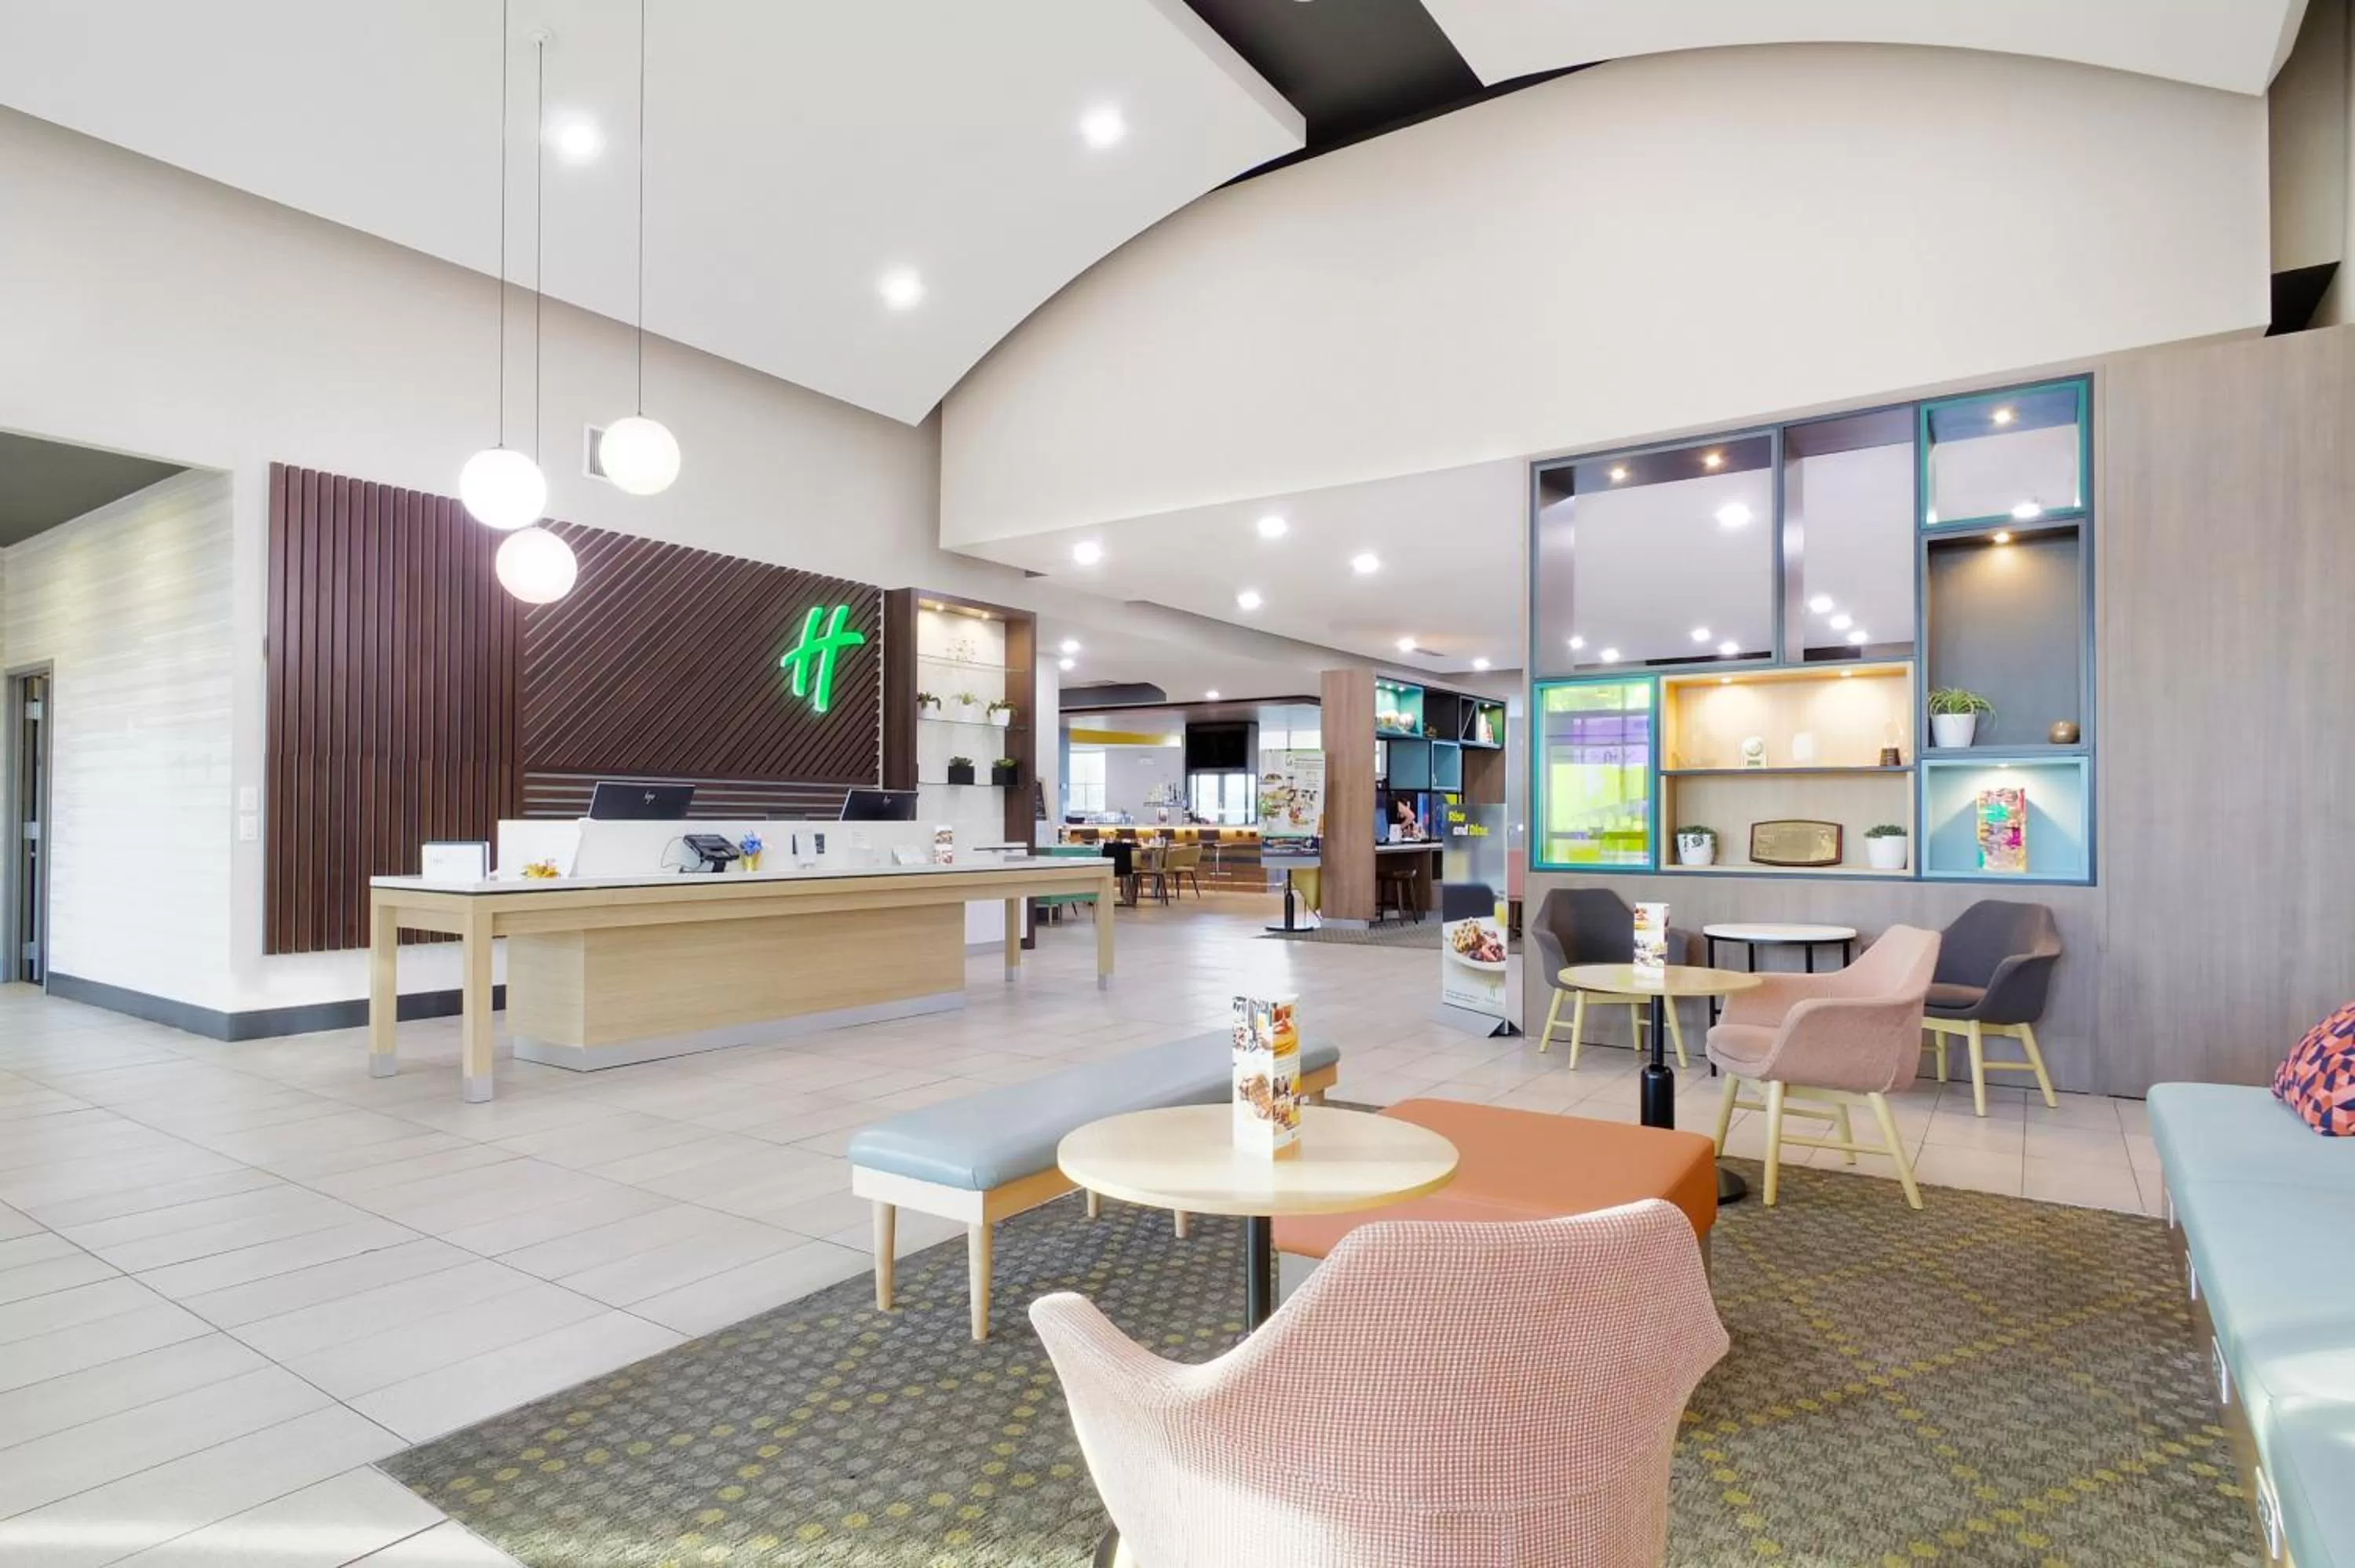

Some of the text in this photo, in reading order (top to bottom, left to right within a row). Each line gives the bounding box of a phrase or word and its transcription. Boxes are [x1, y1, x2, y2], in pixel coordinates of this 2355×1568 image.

[1448, 811, 1466, 822] Rise
[1452, 823, 1489, 837] and Dine
